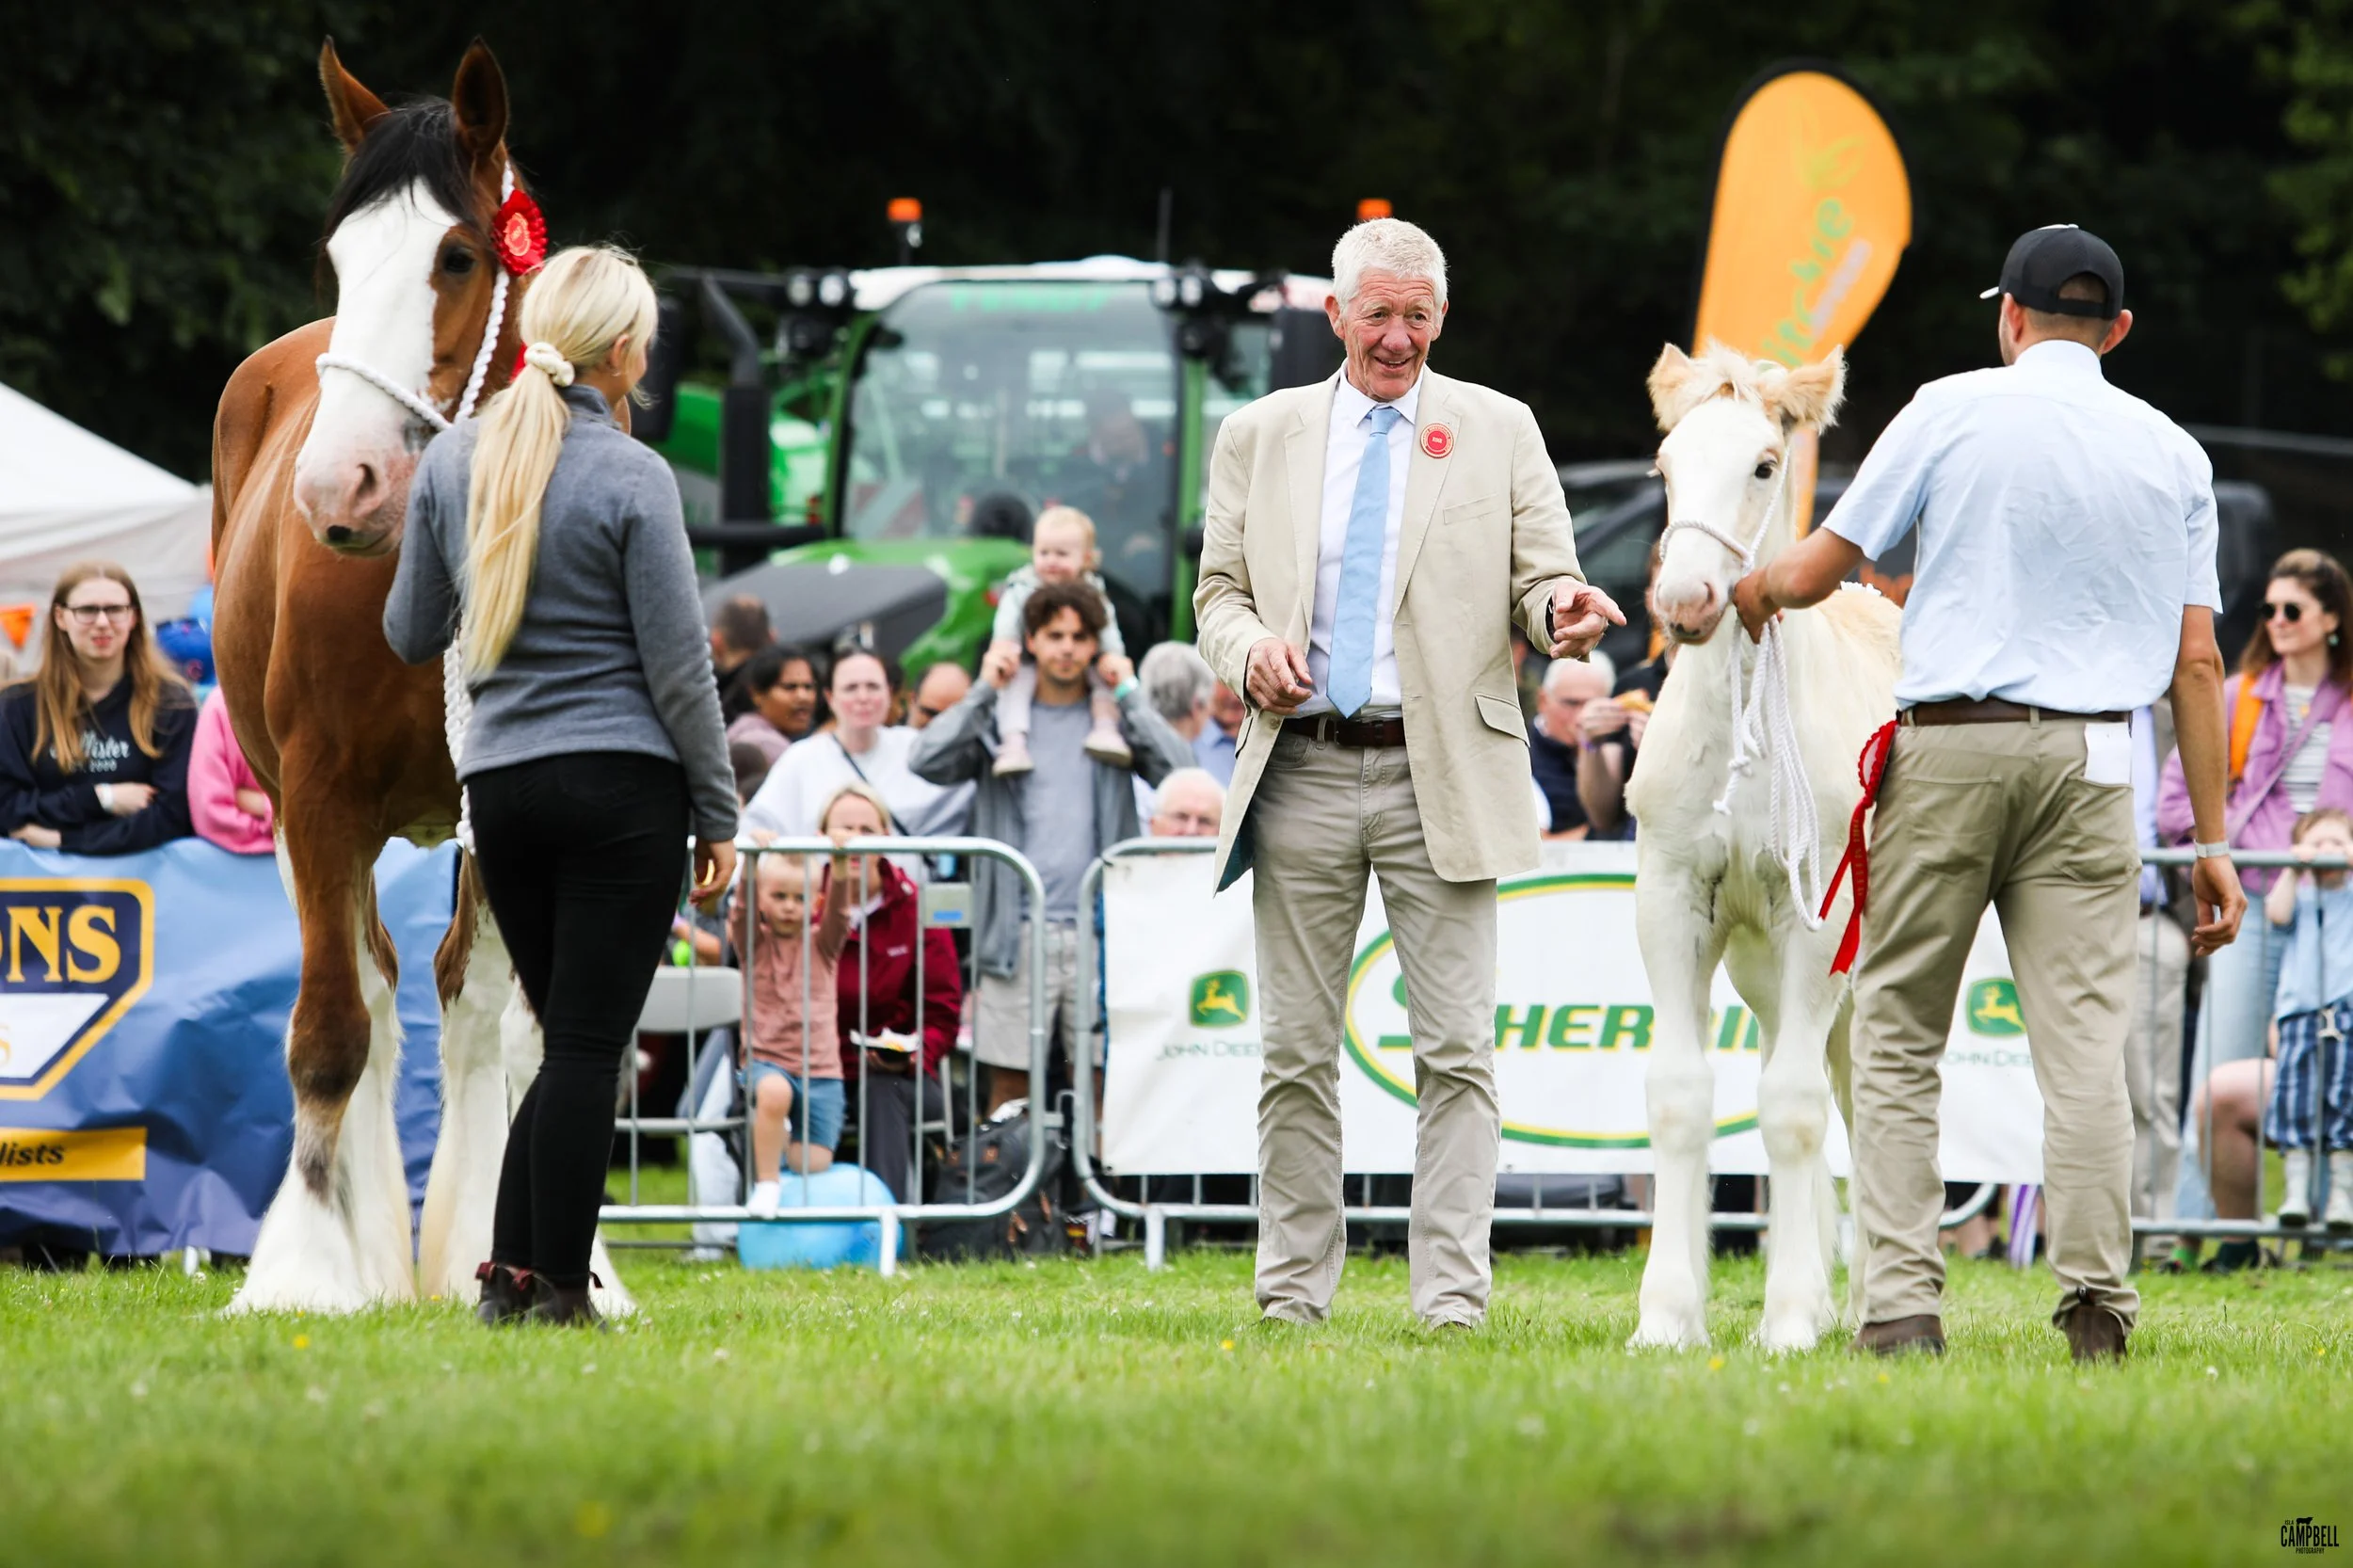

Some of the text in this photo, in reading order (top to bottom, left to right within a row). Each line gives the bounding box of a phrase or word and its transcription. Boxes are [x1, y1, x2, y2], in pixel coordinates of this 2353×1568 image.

[0, 904, 120, 984] NS
[1213, 1040, 1260, 1057] DEE
[1944, 1051, 1990, 1065] OHN
